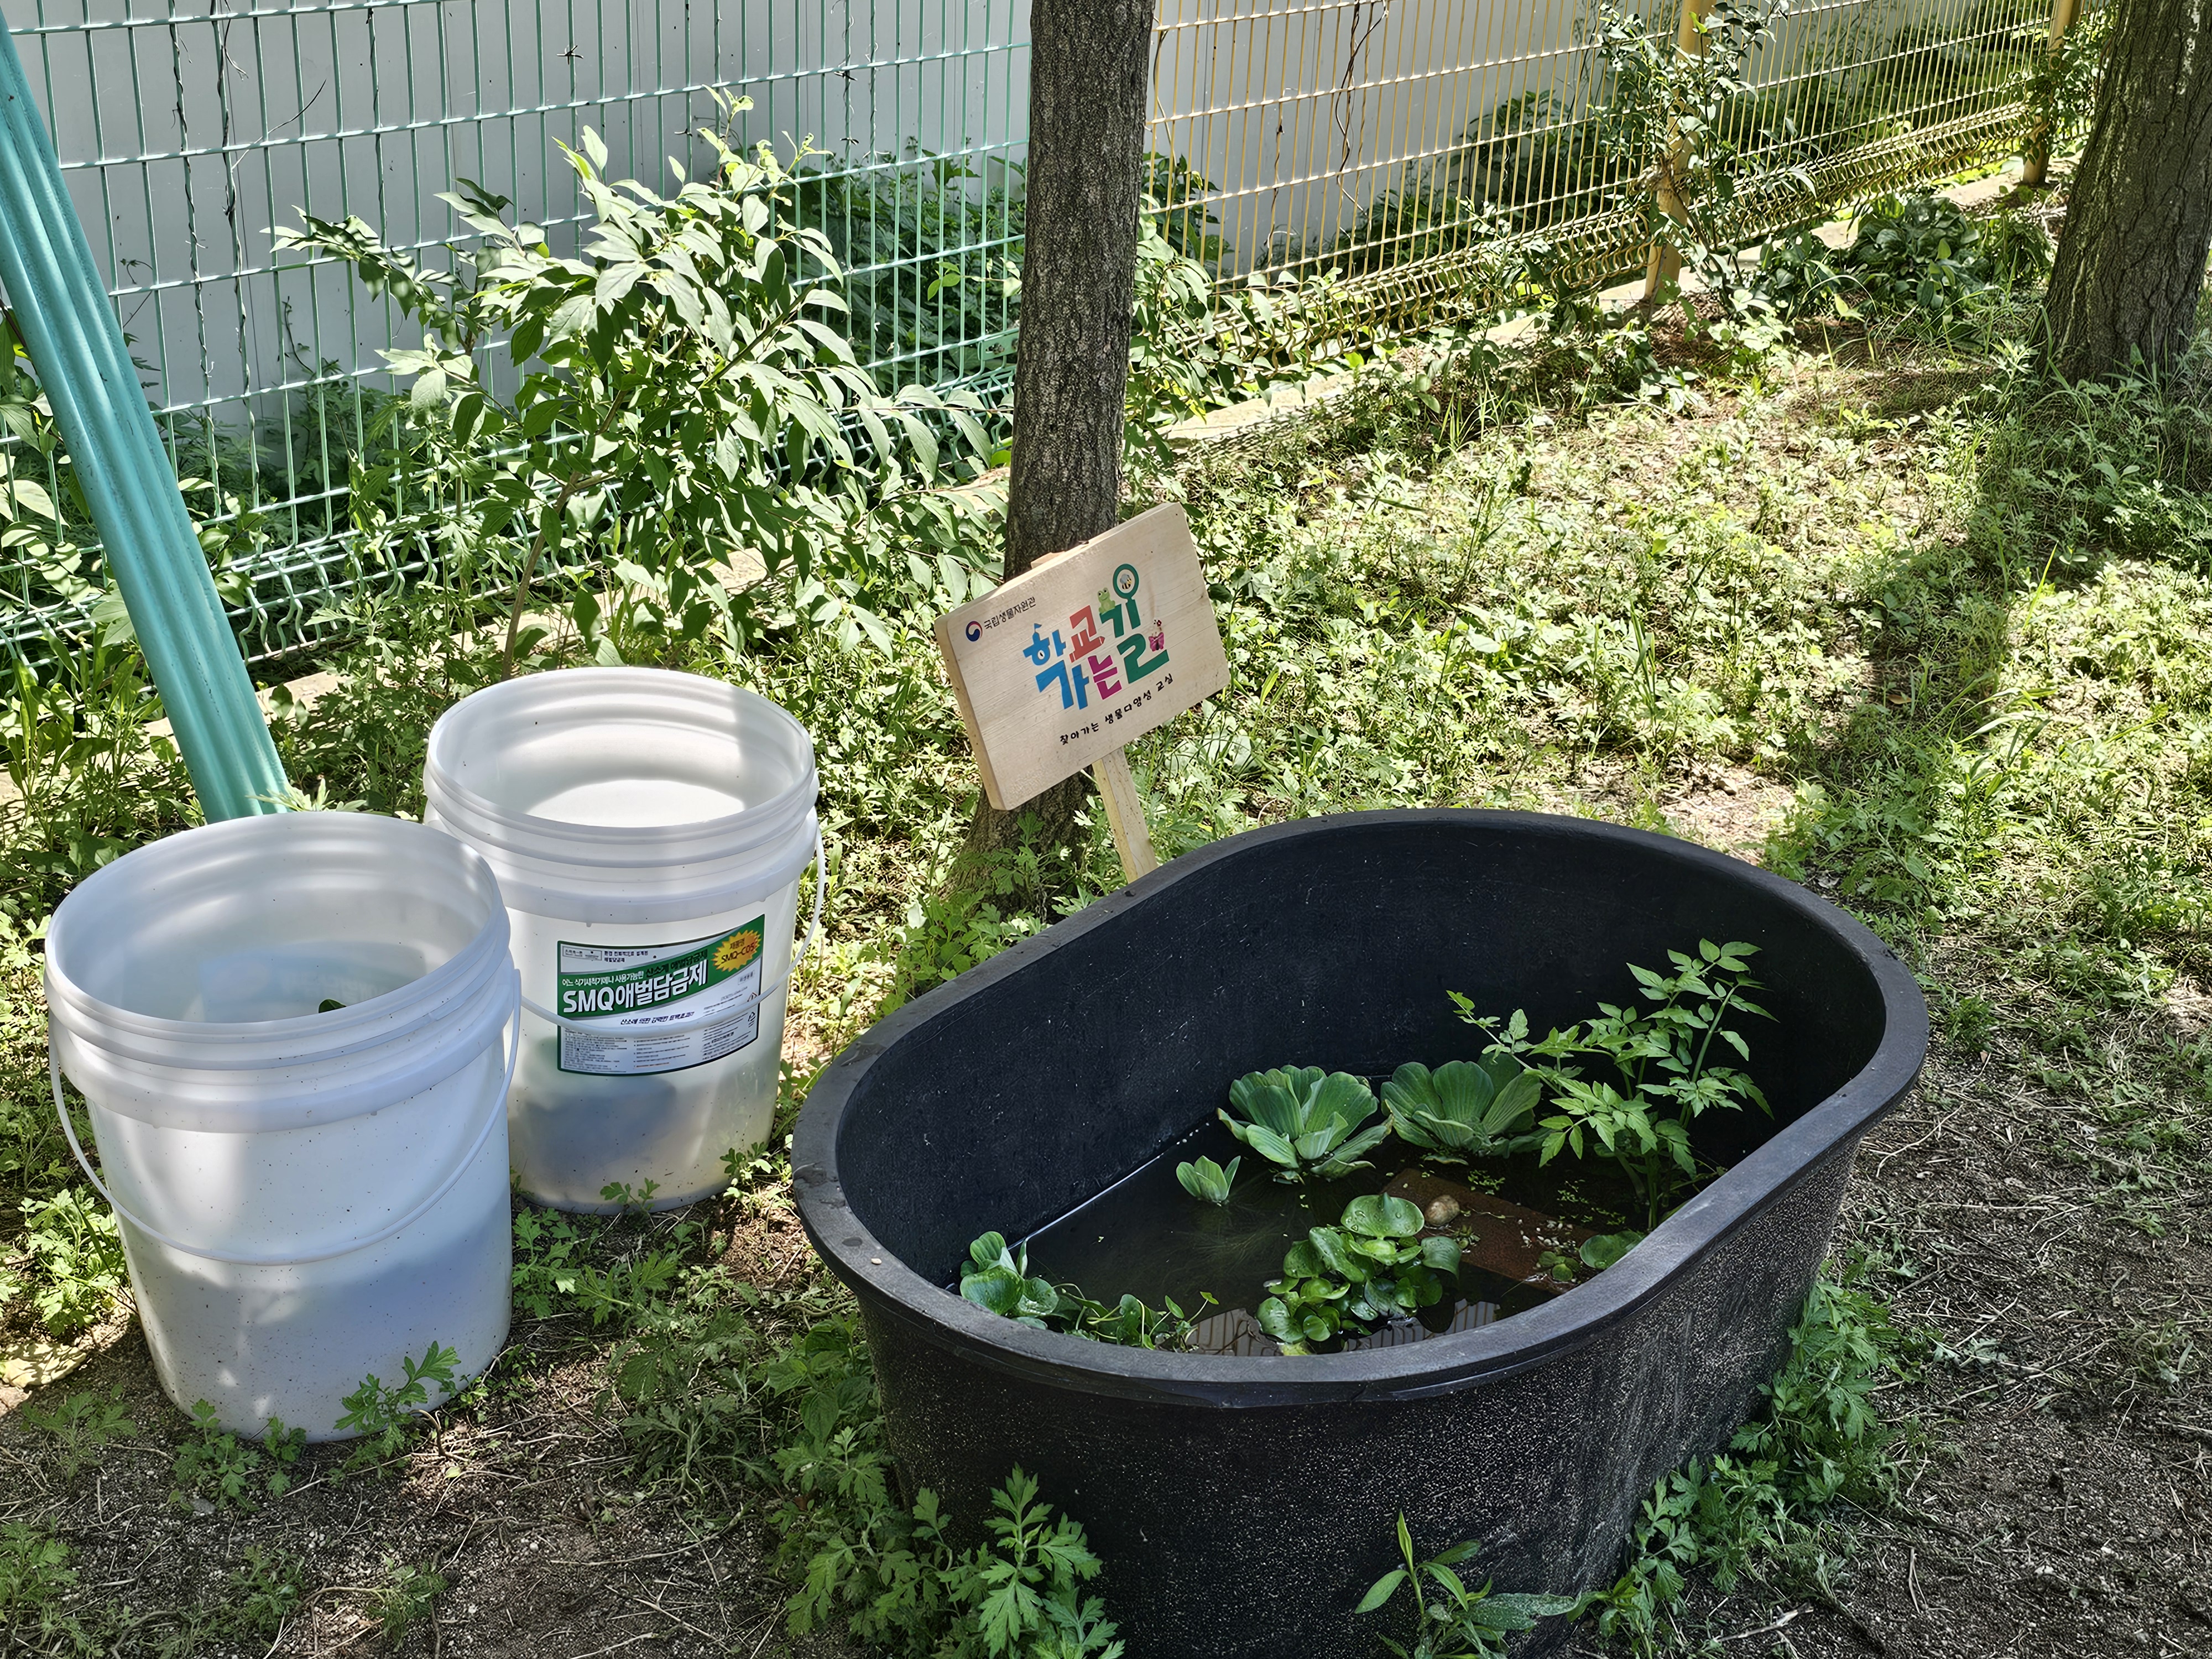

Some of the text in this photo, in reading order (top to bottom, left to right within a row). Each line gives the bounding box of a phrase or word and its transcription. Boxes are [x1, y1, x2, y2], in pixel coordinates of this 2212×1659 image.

[984, 597, 1036, 629] 국립생물자원관
[1035, 655, 1122, 710] 가는
[1060, 673, 1173, 745] 찾아가는 생물다양성 교실
[562, 978, 574, 987] 어느
[563, 959, 708, 1013] SMQ애벌담금제
